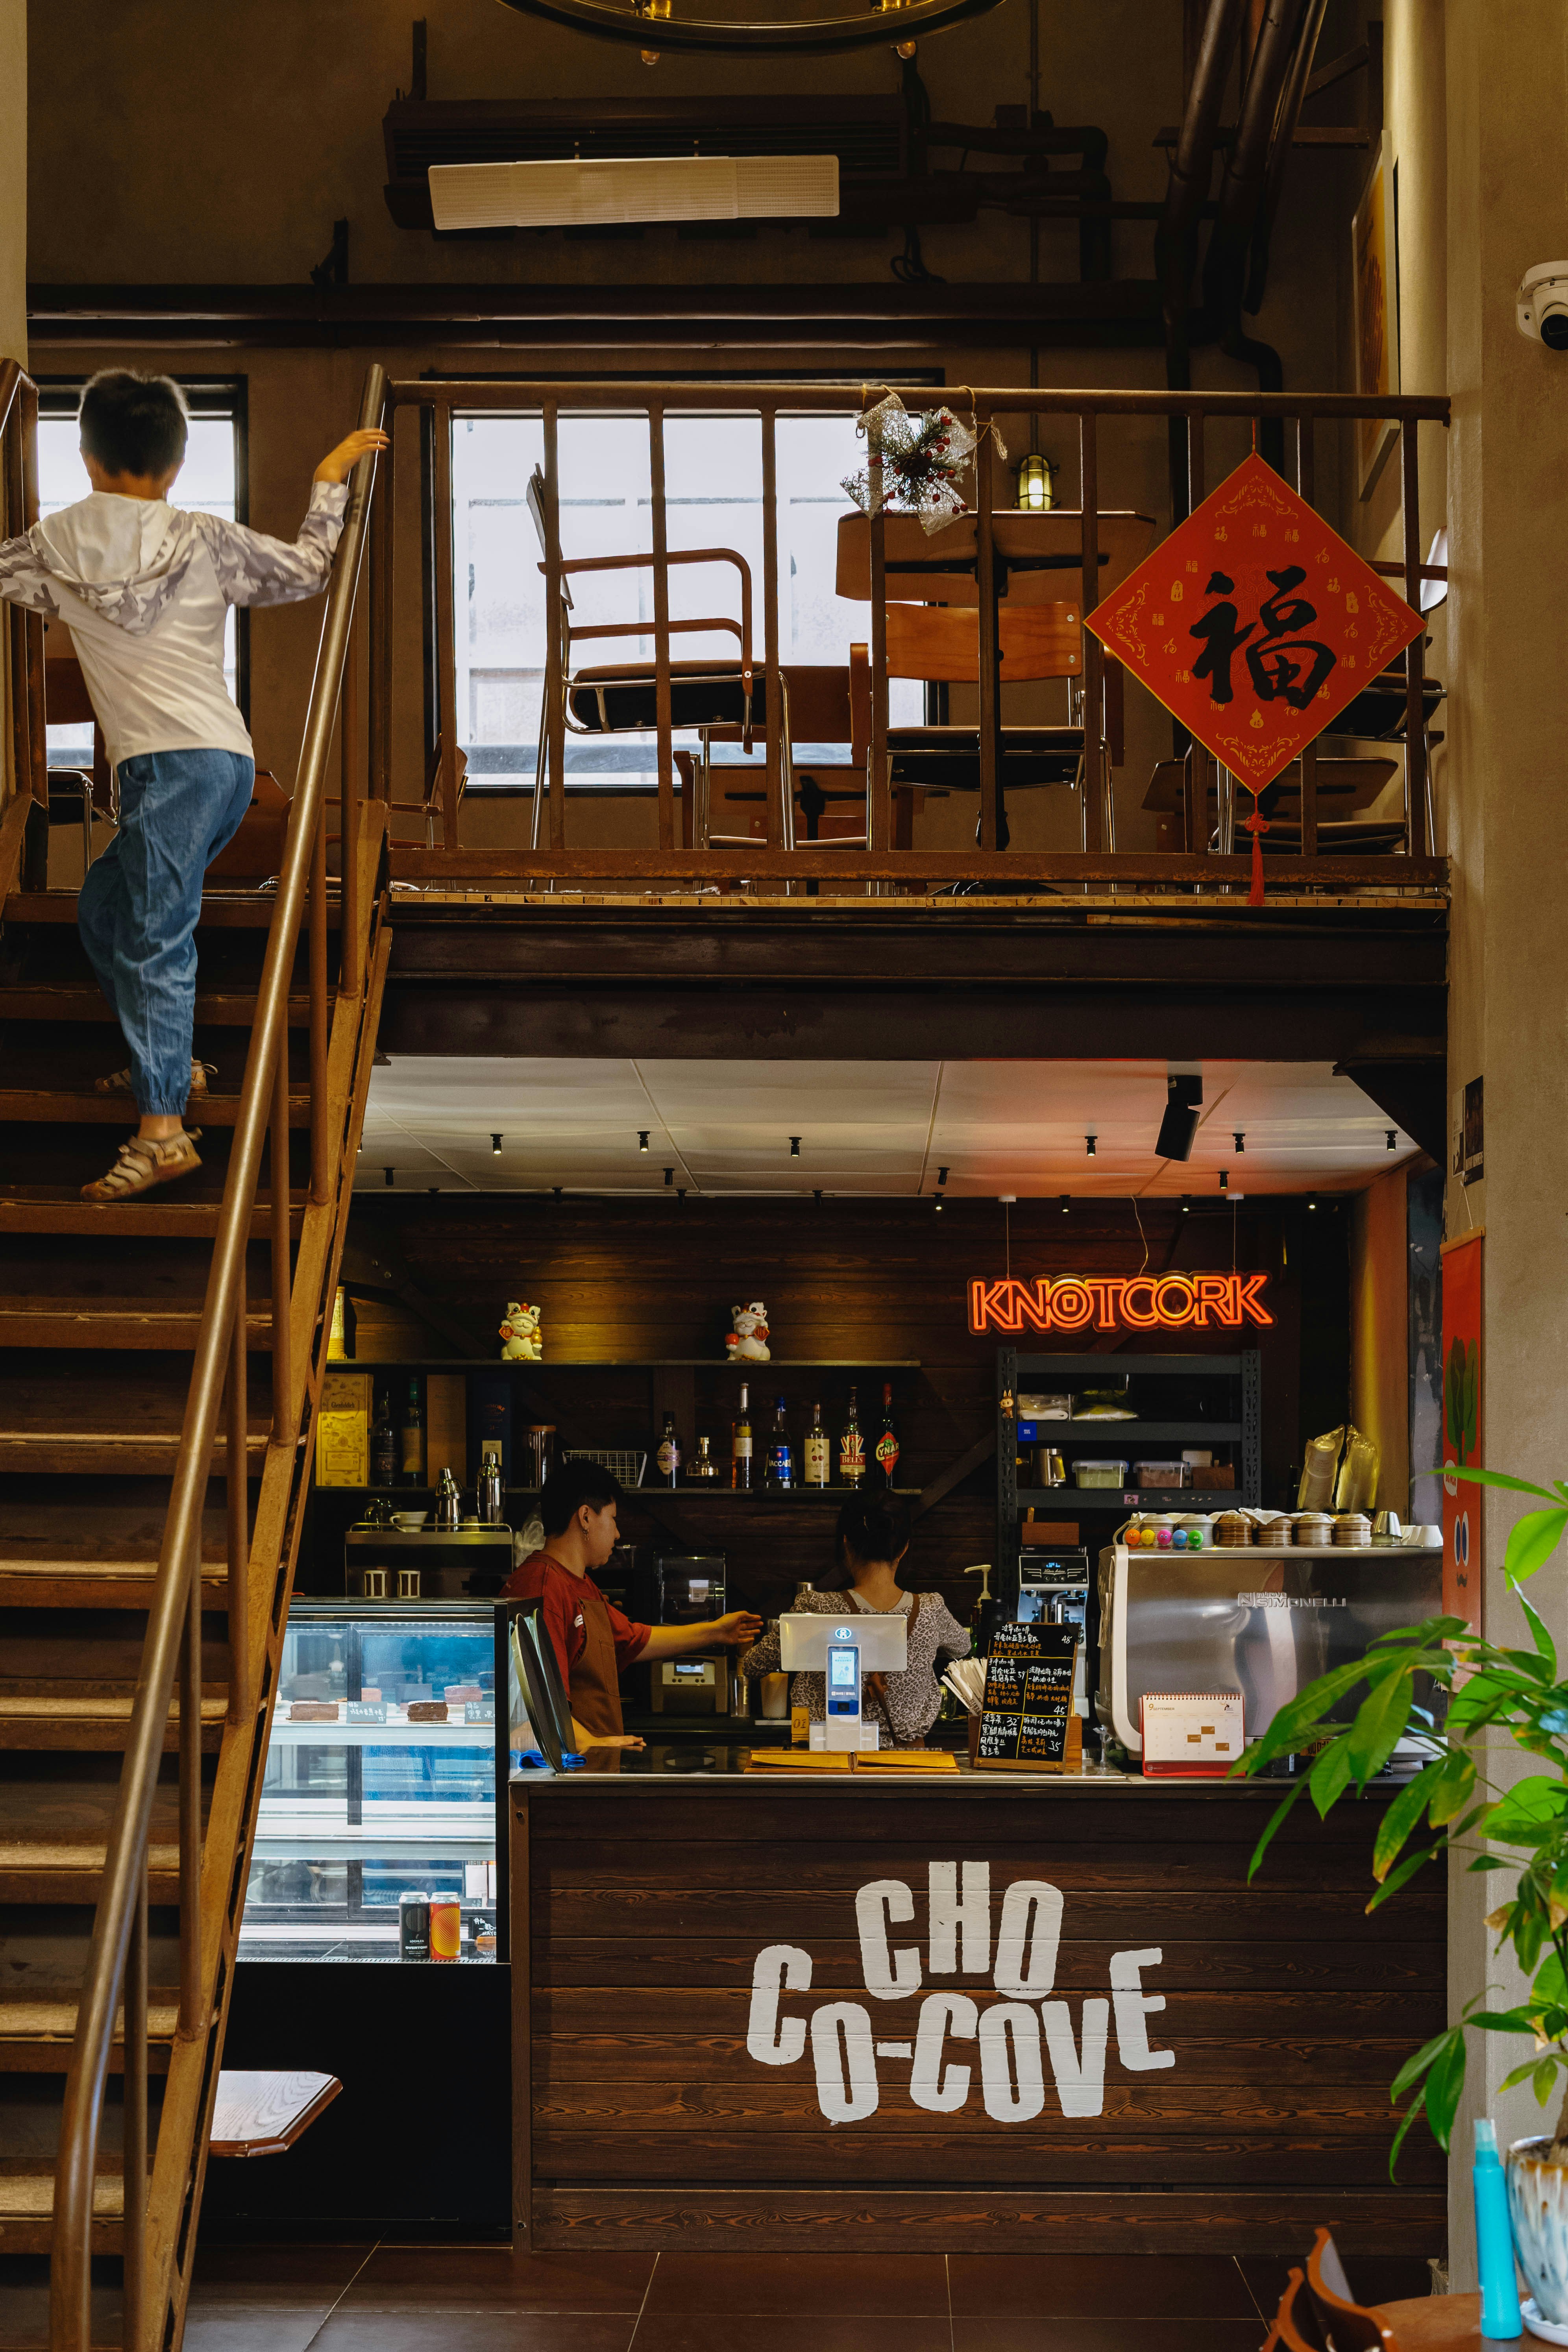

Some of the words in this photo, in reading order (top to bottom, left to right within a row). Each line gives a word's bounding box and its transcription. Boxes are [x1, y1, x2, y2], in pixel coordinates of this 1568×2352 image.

[1214, 526, 1228, 542] 福
[1253, 524, 1267, 538] 福
[1285, 529, 1299, 543] 福
[1315, 548, 1329, 564] 福
[1186, 560, 1198, 573] 福
[1327, 577, 1340, 593] 福
[1152, 614, 1164, 626] 福
[1189, 565, 1337, 710] 福
[1344, 622, 1358, 638] 福
[1162, 638, 1177, 654] 福
[1341, 655, 1355, 668] 福
[1176, 670, 1190, 683] 福
[973, 1275, 1273, 1329] KNOTCORK
[876, 1442, 899, 1461] CYNAR
[769, 1459, 791, 1468] VACCARI
[1256, 1597, 1346, 1607] SIMONELLI
[989, 1658, 1015, 1666] 手冲咖啡
[991, 1667, 1016, 1675] 哥伦比亚
[855, 1861, 1064, 2000] CHO
[747, 1944, 1175, 2124] CO-COVE
